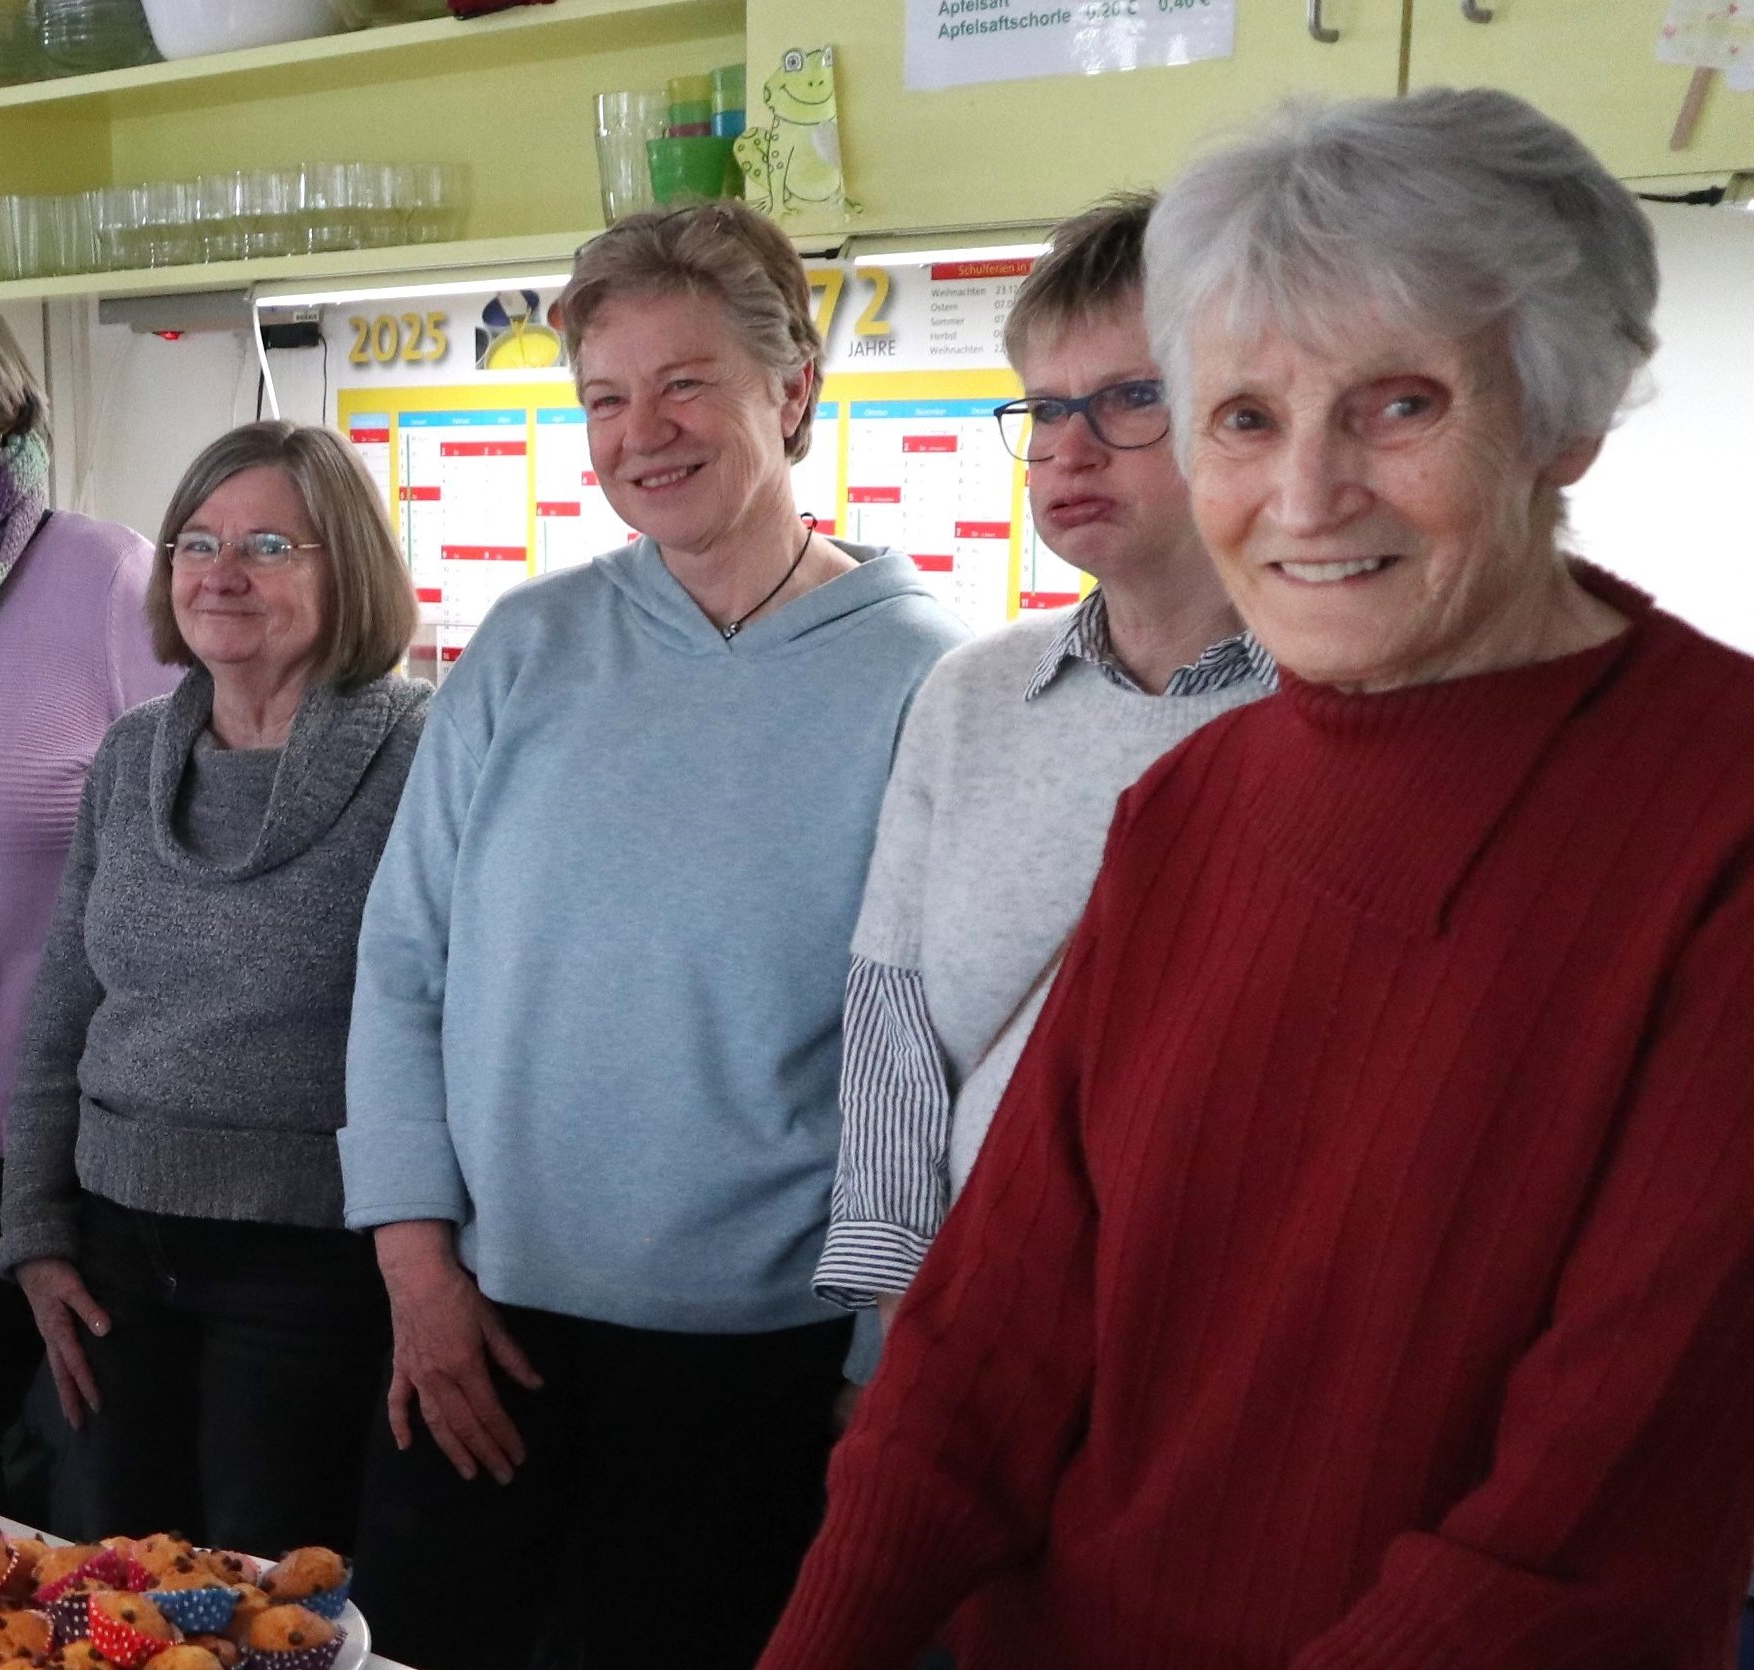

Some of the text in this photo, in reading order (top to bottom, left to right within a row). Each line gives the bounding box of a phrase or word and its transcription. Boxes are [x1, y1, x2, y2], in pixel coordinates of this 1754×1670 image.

[938, 8, 1071, 40] Apfelsaftschorle
[958, 263, 1013, 276] Schulferien
[931, 287, 986, 297] Weihnachten
[806, 266, 891, 339] 72
[931, 303, 958, 312] Ostern
[931, 318, 965, 326] Sommer
[349, 311, 447, 363] 2025
[930, 332, 957, 341] Herbst
[848, 340, 896, 357] JAHRE
[930, 344, 984, 355] Weihnachten
